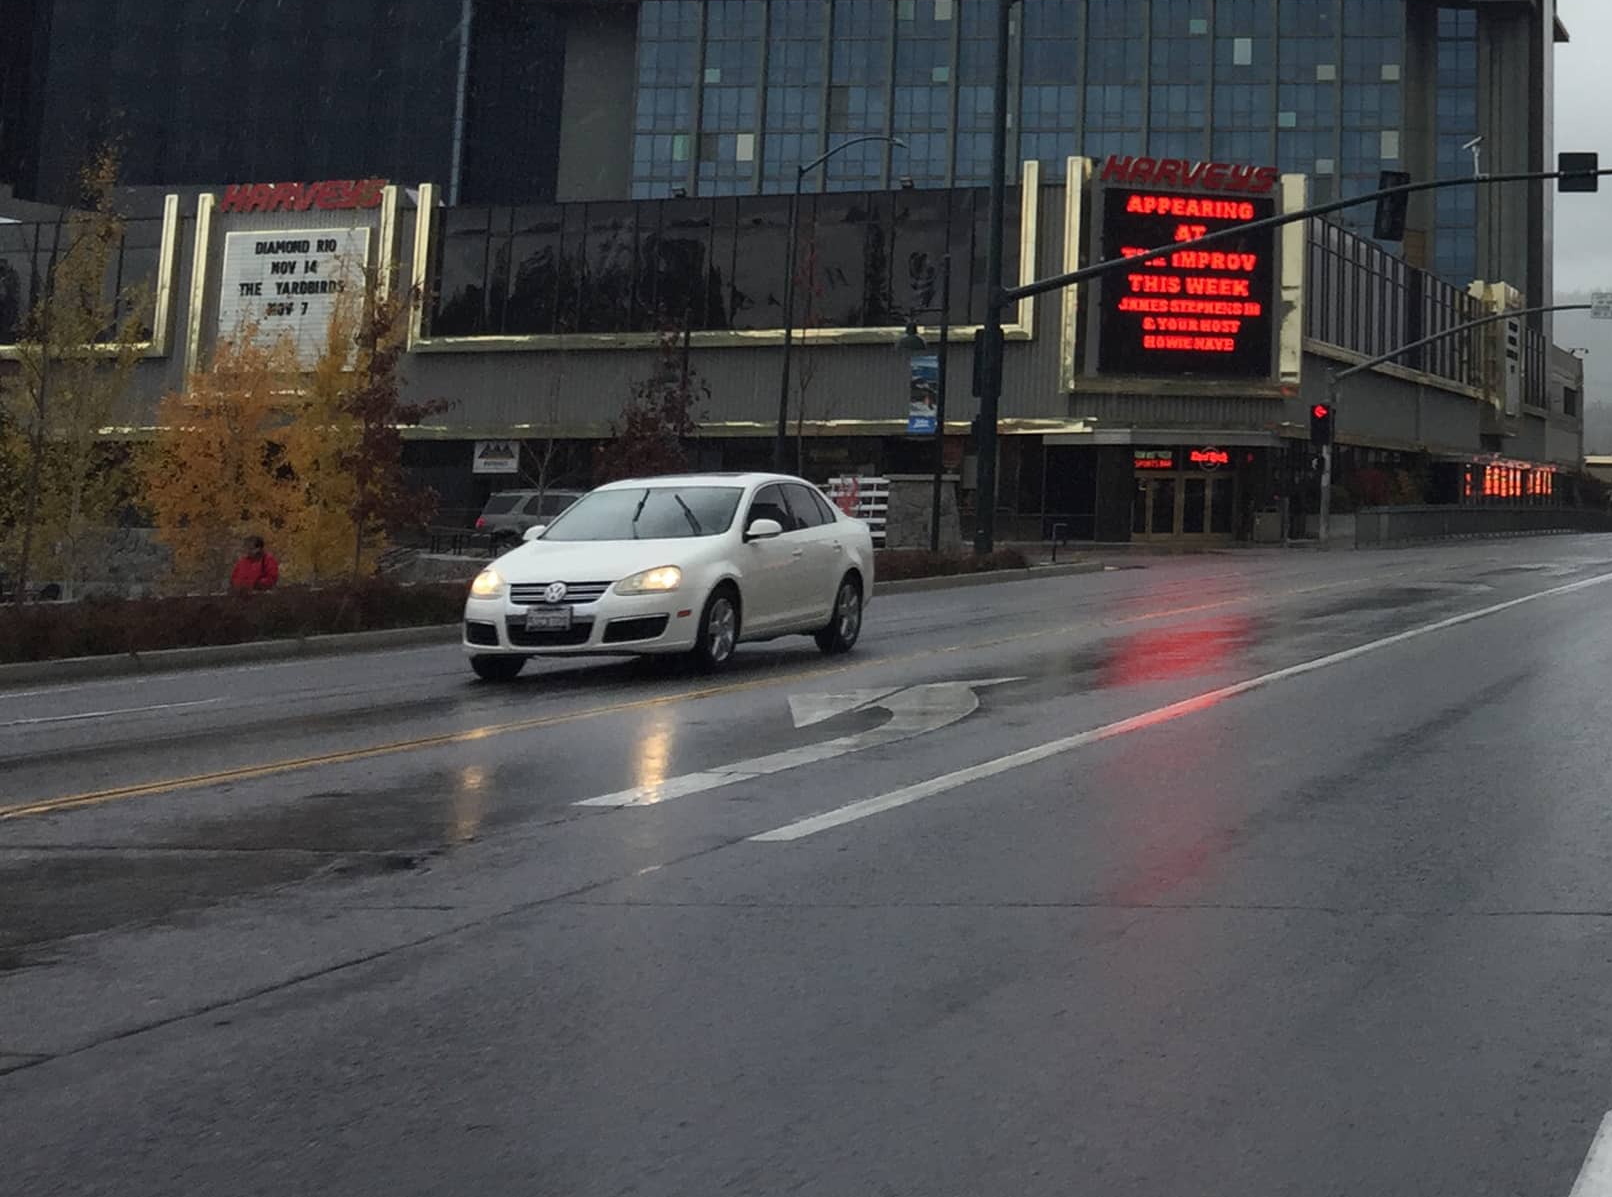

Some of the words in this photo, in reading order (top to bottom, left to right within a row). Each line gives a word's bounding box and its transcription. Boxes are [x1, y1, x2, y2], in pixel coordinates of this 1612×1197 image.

[1101, 154, 1278, 193] HARVEYS
[220, 179, 388, 213] HARVEYS
[1126, 194, 1254, 220] APPEARING
[255, 240, 310, 255] DIAMOND
[316, 238, 337, 252] RIO
[270, 260, 296, 275] NOV
[303, 259, 318, 274] 14
[1171, 251, 1256, 271] IMPROV
[239, 282, 262, 297] THE
[275, 279, 345, 296] YARDBIRDS
[1128, 274, 1181, 293] THIS
[1185, 276, 1249, 297] WEEK
[301, 301, 309, 315] 7
[1118, 297, 1169, 312] JAMES
[1170, 299, 1242, 315] STEPHENS
[1157, 317, 1199, 332] YOUR
[1200, 319, 1240, 333] HOST
